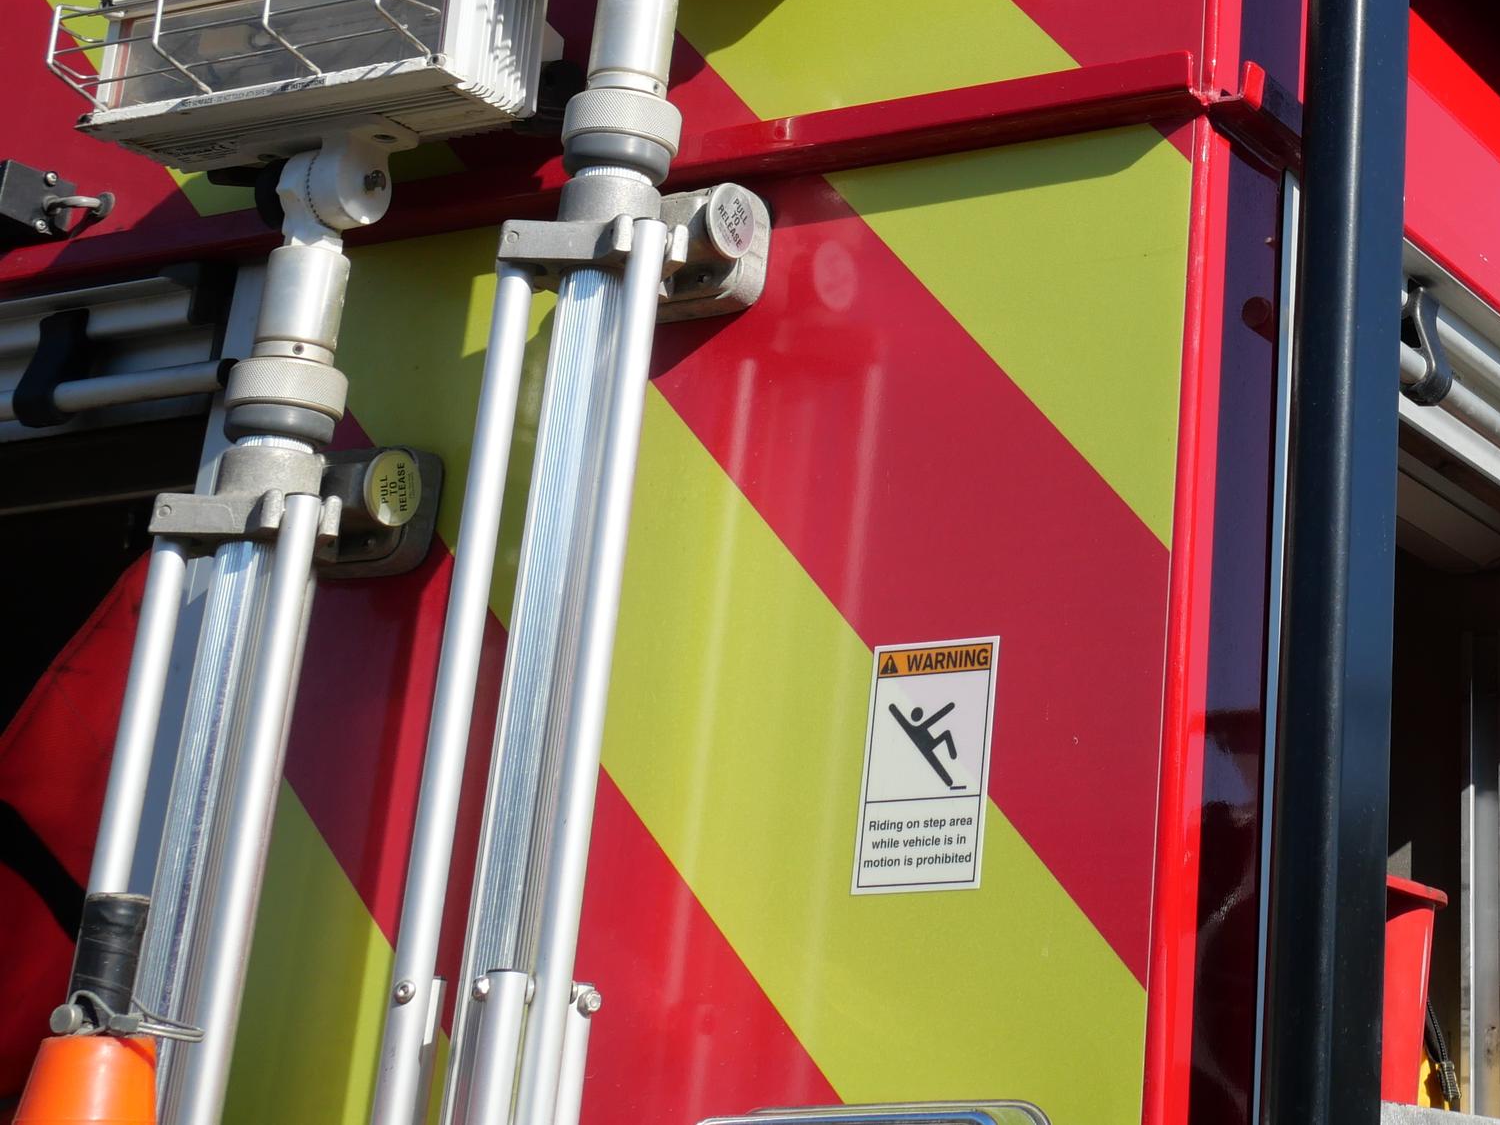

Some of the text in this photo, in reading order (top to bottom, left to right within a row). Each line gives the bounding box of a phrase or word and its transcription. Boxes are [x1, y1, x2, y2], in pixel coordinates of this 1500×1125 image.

[731, 212, 741, 227] TO
[733, 198, 748, 225] PULL
[718, 204, 744, 248] RELEASE
[380, 475, 389, 504] PULL
[389, 481, 398, 496] TO
[397, 463, 408, 512] RELEASE
[906, 648, 989, 672] WARNING
[869, 817, 973, 832] Riding on step area
[872, 834, 966, 850] while vehicle is in
[863, 852, 972, 868] motion is prohibited
